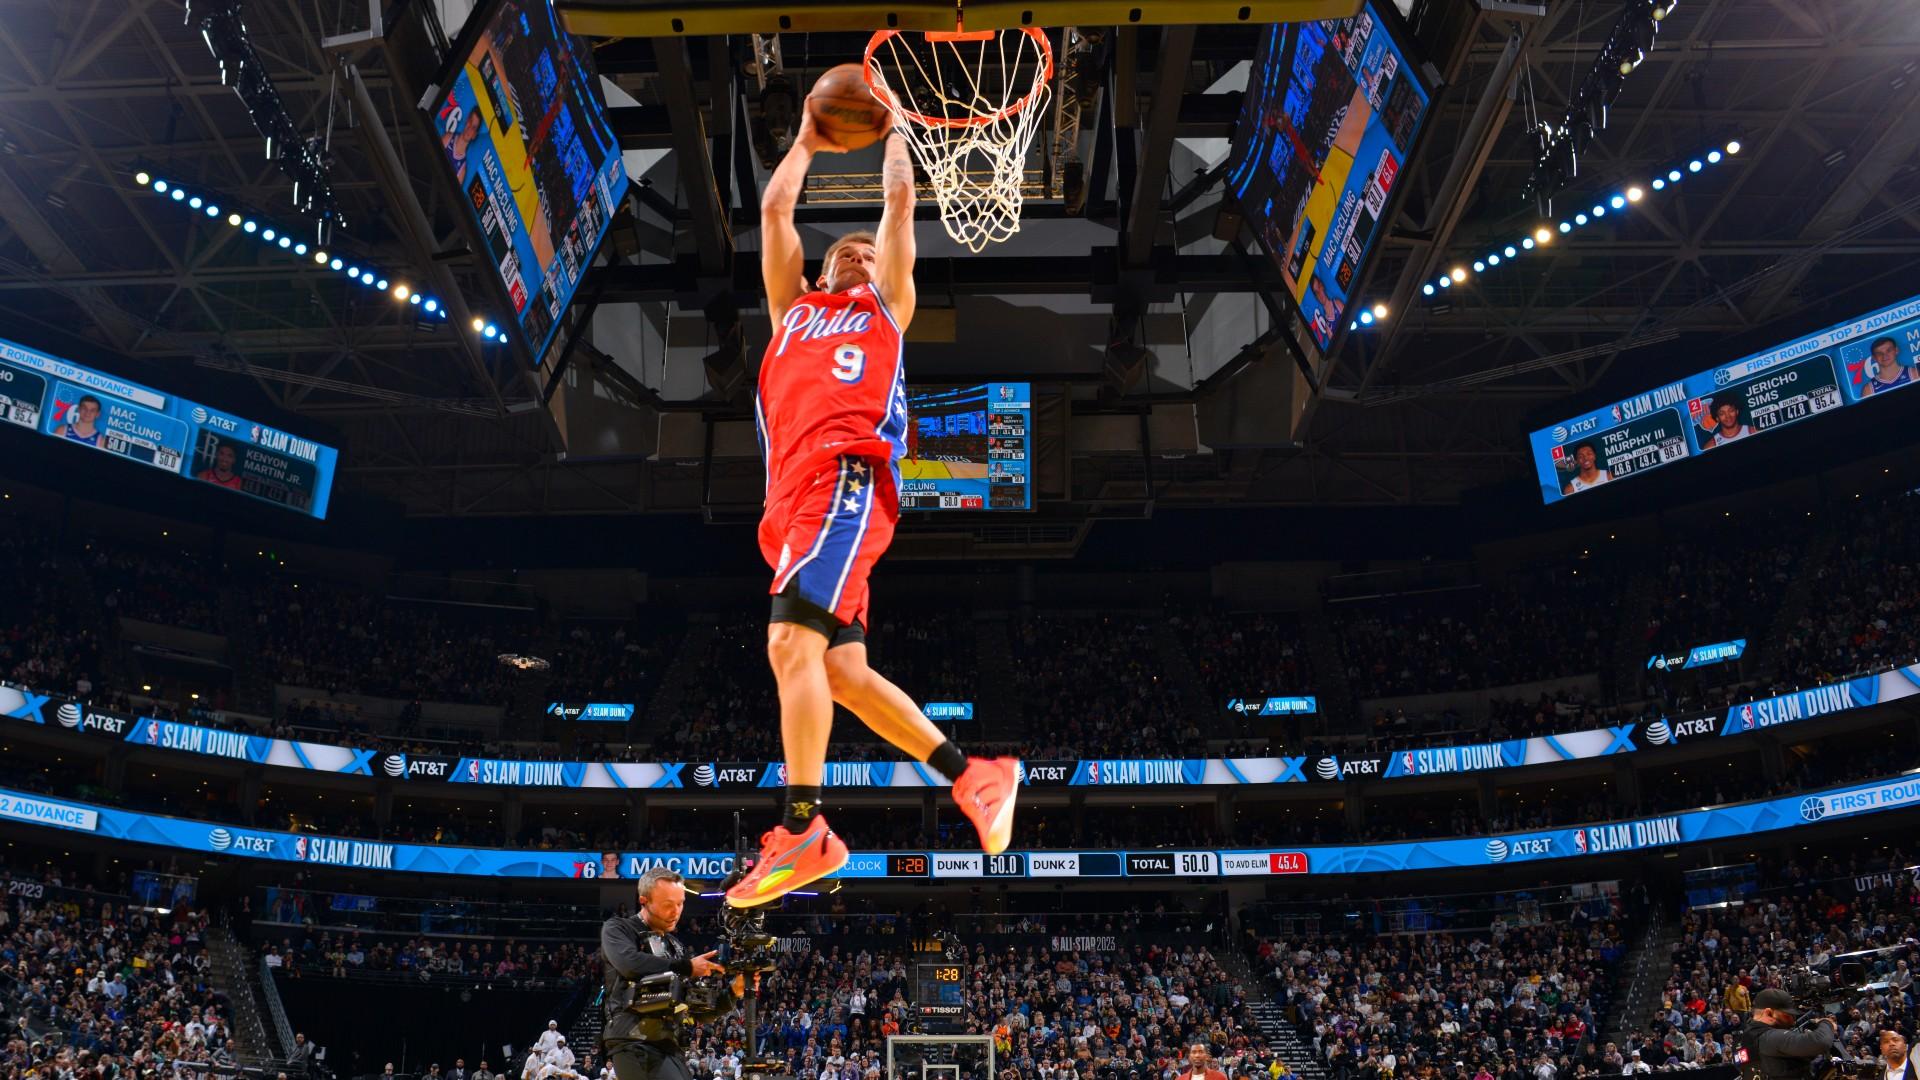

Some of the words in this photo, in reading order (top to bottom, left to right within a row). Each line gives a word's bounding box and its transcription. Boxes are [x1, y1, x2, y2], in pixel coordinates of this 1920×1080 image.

[483, 149, 495, 181] MAC
[1323, 242, 1338, 268] MAC
[1333, 190, 1357, 243] McCLUNG
[776, 301, 872, 356] Phila
[1747, 354, 1778, 372] FIRST
[1780, 340, 1819, 361] ROUND
[1828, 328, 1852, 342] TOP
[1855, 324, 1863, 334] 2
[7, 348, 45, 368] ROUND
[54, 363, 75, 379] TOP
[77, 373, 85, 382] 2
[86, 375, 135, 398] ADVANCE
[832, 343, 866, 384] 9
[1746, 371, 1798, 397] JERICHO
[1813, 387, 1833, 396] TOTAL
[1570, 416, 1597, 436] AT&T
[1622, 394, 1652, 419] SLAM
[1654, 382, 1686, 409] DUNK
[1748, 390, 1779, 408] SIMS
[14, 407, 33, 424] 95.4
[110, 405, 137, 421] MAC
[1759, 413, 1777, 429] 47.6
[1787, 404, 1805, 419] 47.8
[1815, 393, 1836, 410] 95.4
[107, 417, 162, 441] McCLUNG
[208, 415, 238, 432] AT&T
[261, 428, 288, 452] SLAM
[289, 438, 318, 462] DUNK
[1602, 428, 1630, 445] TREY
[108, 438, 126, 453] 50.0
[1604, 433, 1651, 457] MURPHY
[1654, 428, 1665, 441] III
[159, 453, 177, 468] 50.0
[246, 449, 288, 469] KENYON
[1640, 453, 1657, 468] 49.4
[1665, 445, 1683, 460] 96.0
[244, 460, 285, 480] MARTIN
[901, 482, 936, 491] cCLUNG
[901, 497, 915, 507] 50.0
[945, 497, 958, 507] 50.0
[1667, 657, 1684, 666] AT&T
[1700, 649, 1718, 661] SLAM
[1719, 645, 1737, 658] DUNK
[593, 707, 609, 717] SLAM
[610, 708, 626, 717] DUNK
[932, 706, 948, 716] SLAM
[949, 706, 965, 716] DUNK
[1274, 701, 1290, 711] SLAM
[1291, 701, 1308, 711] DUNK
[1675, 717, 1717, 738] AT&T
[1757, 692, 1802, 727] SLAM
[1806, 681, 1854, 718] DUNK
[84, 714, 125, 734] AT&T
[162, 724, 202, 752] SLAM
[206, 731, 249, 760] DUNK
[1342, 759, 1381, 775] AT&T
[1418, 748, 1458, 774] SLAM
[1461, 744, 1504, 770] DUNK
[408, 760, 448, 776] AT&T
[483, 761, 520, 785] SLAM
[525, 763, 563, 786] DUNK
[718, 768, 756, 783] AT&T
[833, 763, 871, 786] DUNK
[1029, 767, 1067, 781] AT&T
[1103, 761, 1140, 784] SLAM
[1145, 760, 1185, 784] DUNK
[1830, 791, 1878, 811] FIRST
[1882, 783, 1920, 802] ROU
[0, 799, 9, 811] 2
[13, 802, 84, 824] ADVANCE
[1512, 838, 1552, 857] AT&T
[1590, 824, 1633, 852] SLAM
[1636, 817, 1681, 847] DUNK
[234, 836, 274, 852] AT&T
[310, 839, 348, 865] SLAM
[353, 843, 394, 868] DUNK
[688, 857, 735, 875] McC
[843, 861, 881, 871] CLOCK
[897, 858, 924, 873] 1:28
[937, 860, 969, 870] DUNK
[973, 860, 978, 870] 1
[990, 855, 1017, 874] 50.0
[1033, 860, 1065, 870] DUNK
[1068, 860, 1076, 870] 2
[1132, 859, 1170, 870] TOTAL
[1182, 854, 1209, 873] 50.0
[1225, 859, 1234, 868] TO
[1236, 859, 1250, 869] AVD
[1252, 858, 1268, 868] ELIM
[1278, 855, 1299, 870] 45.4
[792, 937, 811, 953] 2023
[1097, 936, 1115, 951] 2023
[936, 968, 959, 981] 1:28
[932, 1006, 962, 1014] TISSOT
